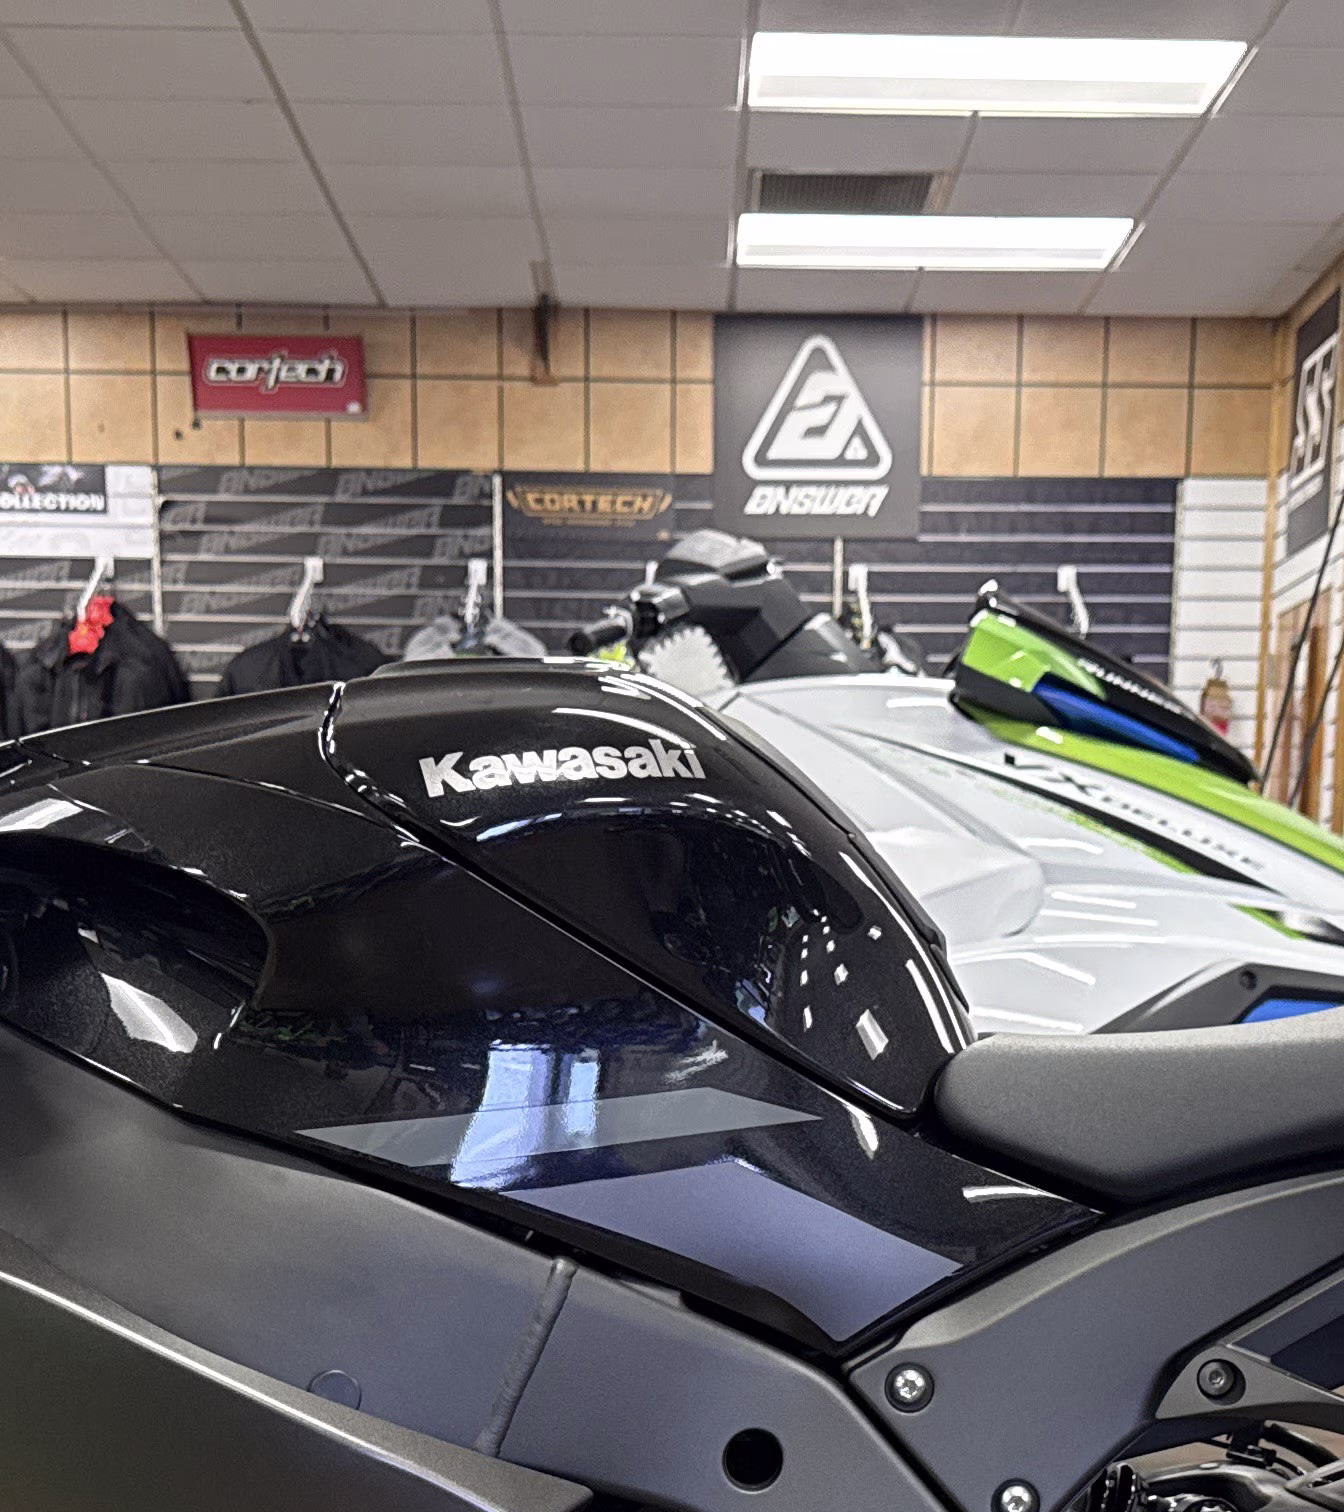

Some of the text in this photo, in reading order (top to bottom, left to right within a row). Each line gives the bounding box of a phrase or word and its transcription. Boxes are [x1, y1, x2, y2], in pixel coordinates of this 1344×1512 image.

[206, 353, 347, 391] cortech
[526, 491, 655, 514] CORTECH
[418, 738, 706, 798] Kawasaki
